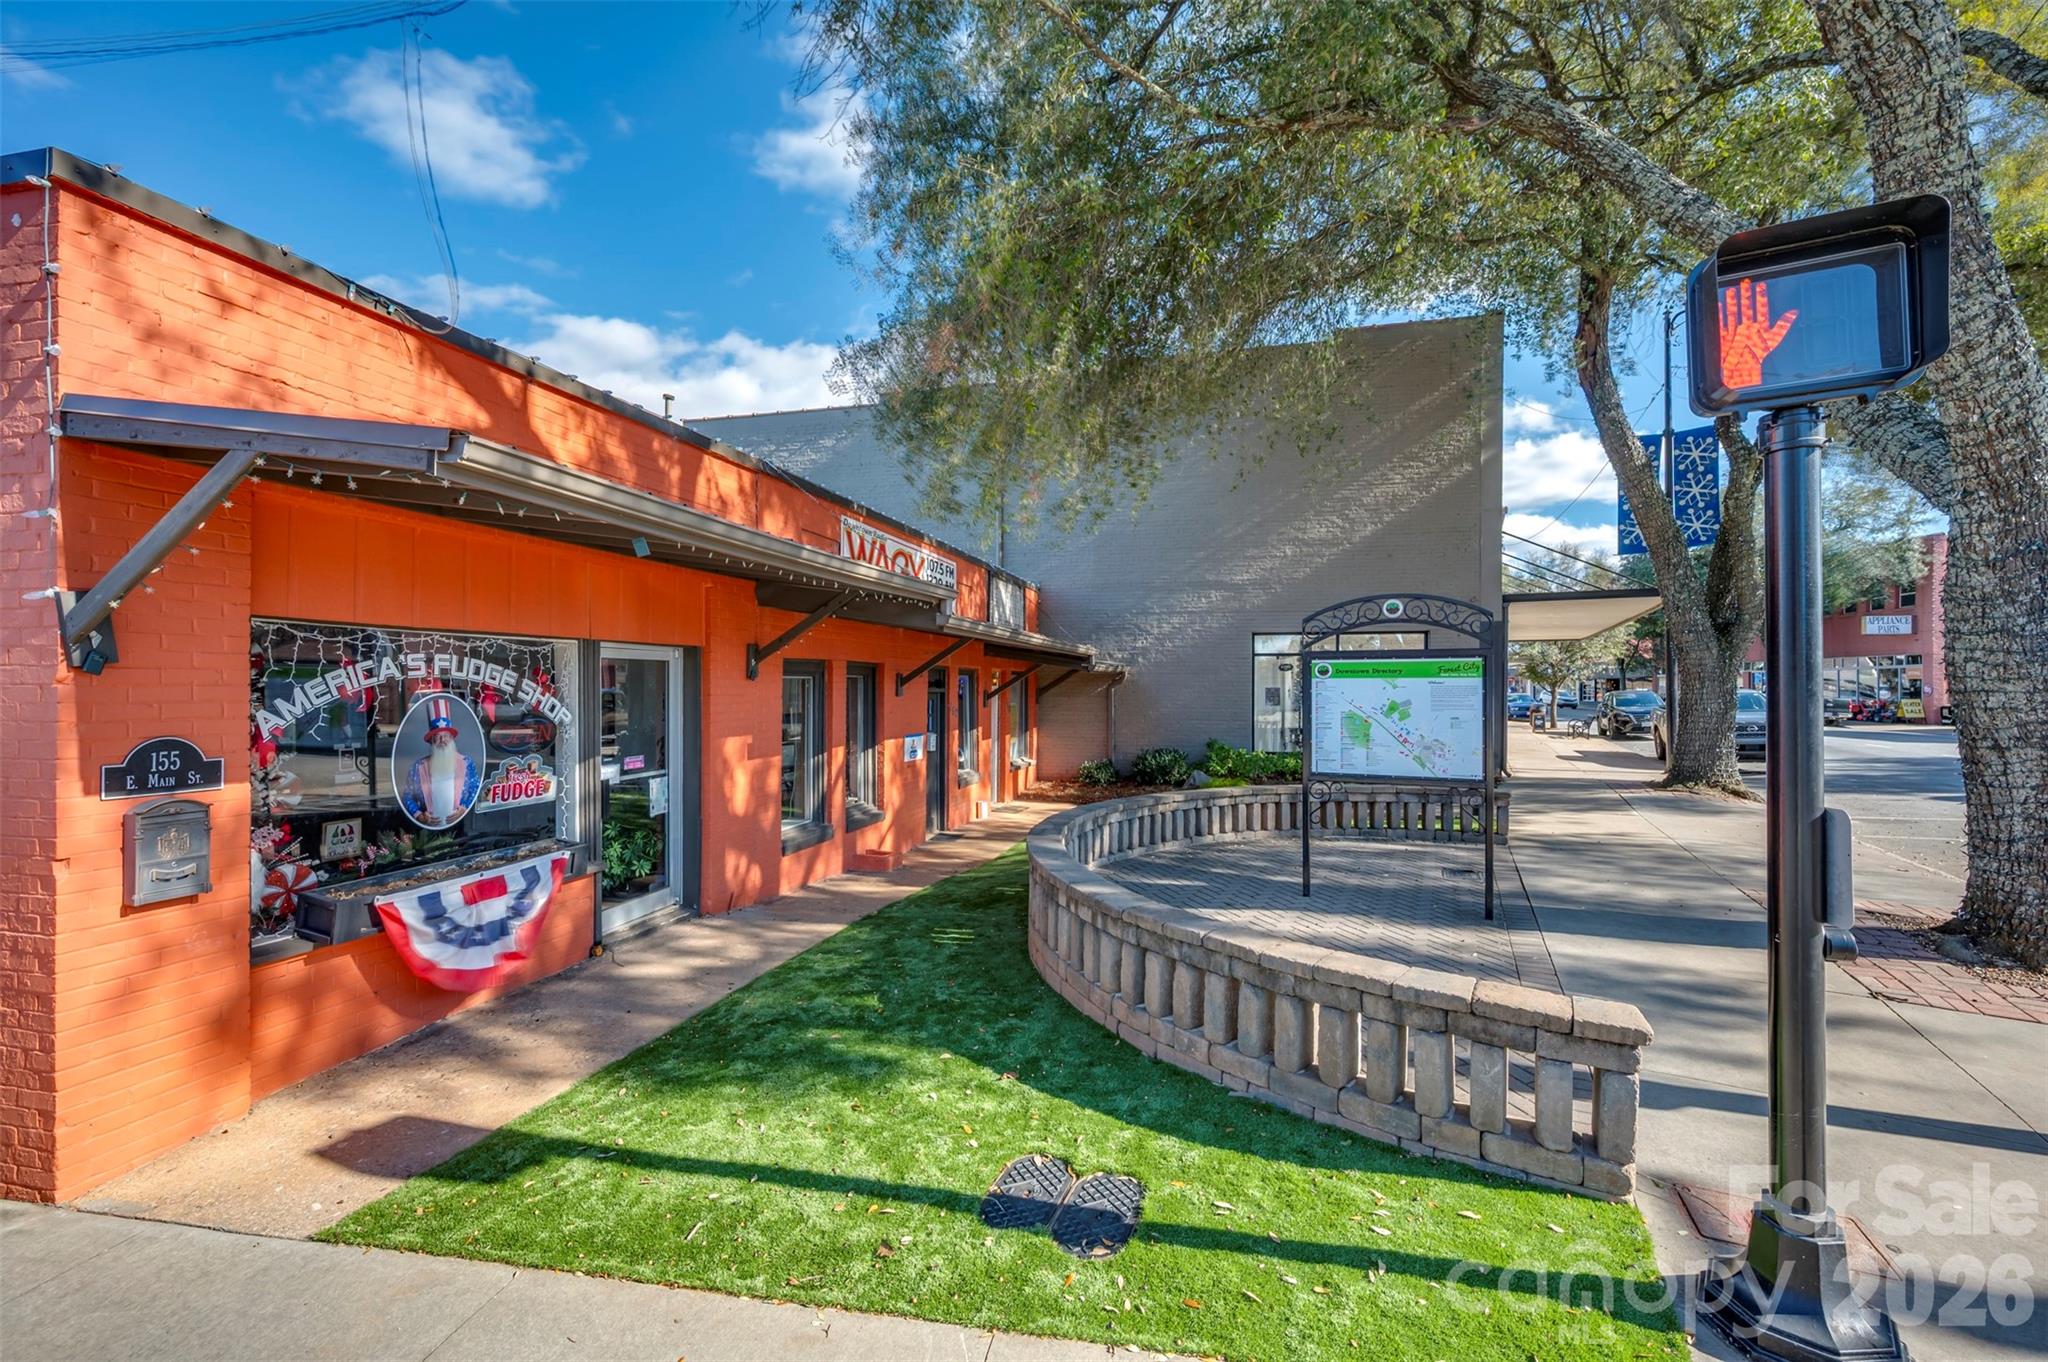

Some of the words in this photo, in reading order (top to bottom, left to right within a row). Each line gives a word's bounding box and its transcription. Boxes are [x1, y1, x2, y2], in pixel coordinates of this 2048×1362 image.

[926, 557, 944, 576] 107.5
[945, 565, 955, 580] FM
[1867, 616, 1911, 625] APPLIANCE
[1877, 625, 1900, 633] PARTS
[1372, 667, 1402, 676] Directory
[1463, 661, 1480, 672] City
[255, 653, 427, 743] AMERICA'S
[434, 653, 519, 694] FUDGE
[517, 678, 572, 726] SHOP
[496, 722, 553, 743] OPEN
[150, 751, 181, 772] 155
[126, 775, 139, 790] E.
[491, 778, 546, 804] FUDGE
